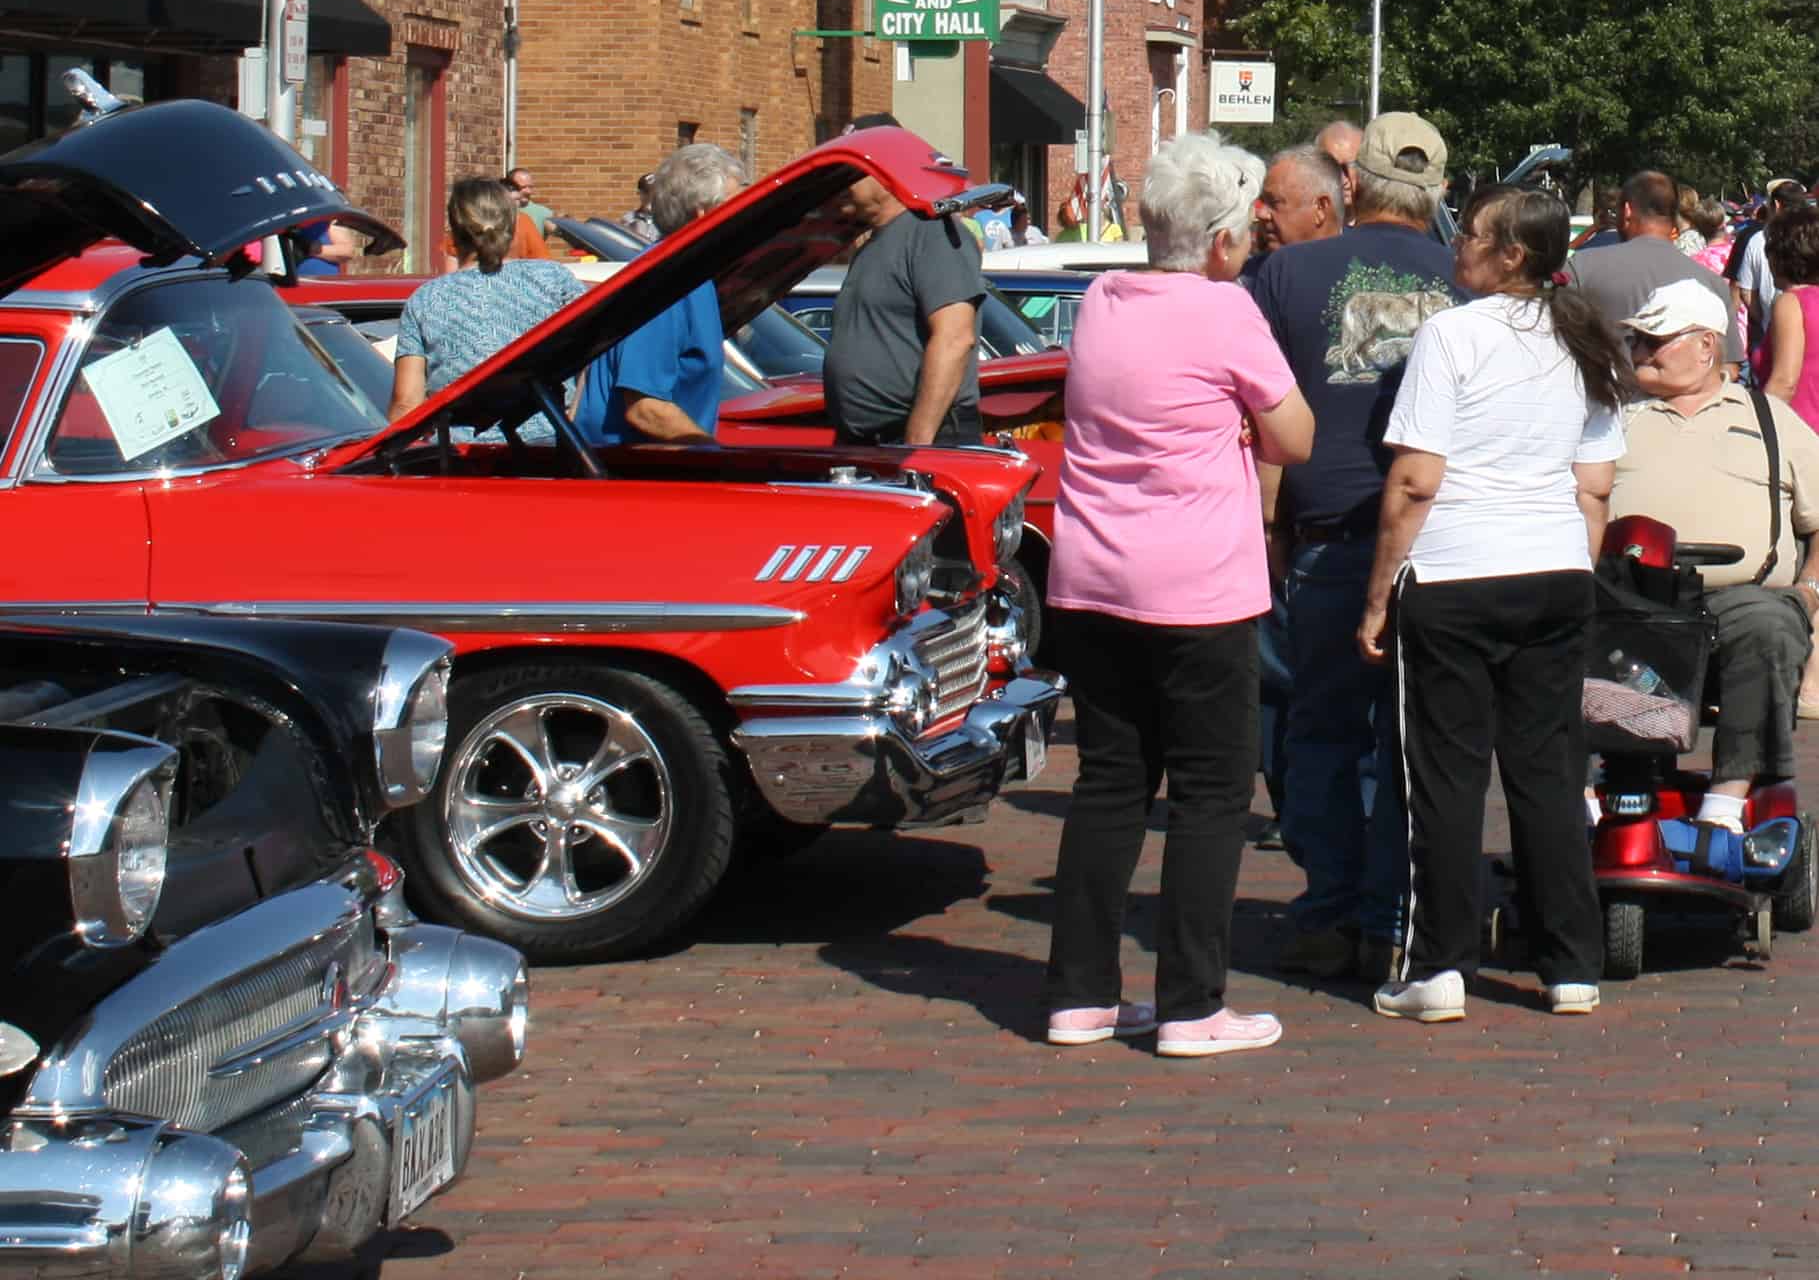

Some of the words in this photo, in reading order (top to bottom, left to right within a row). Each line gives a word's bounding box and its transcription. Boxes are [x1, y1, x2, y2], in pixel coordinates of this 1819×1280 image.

[882, 11, 926, 35] CITY
[935, 11, 985, 35] HALL
[1218, 94, 1272, 105] BEHLEN
